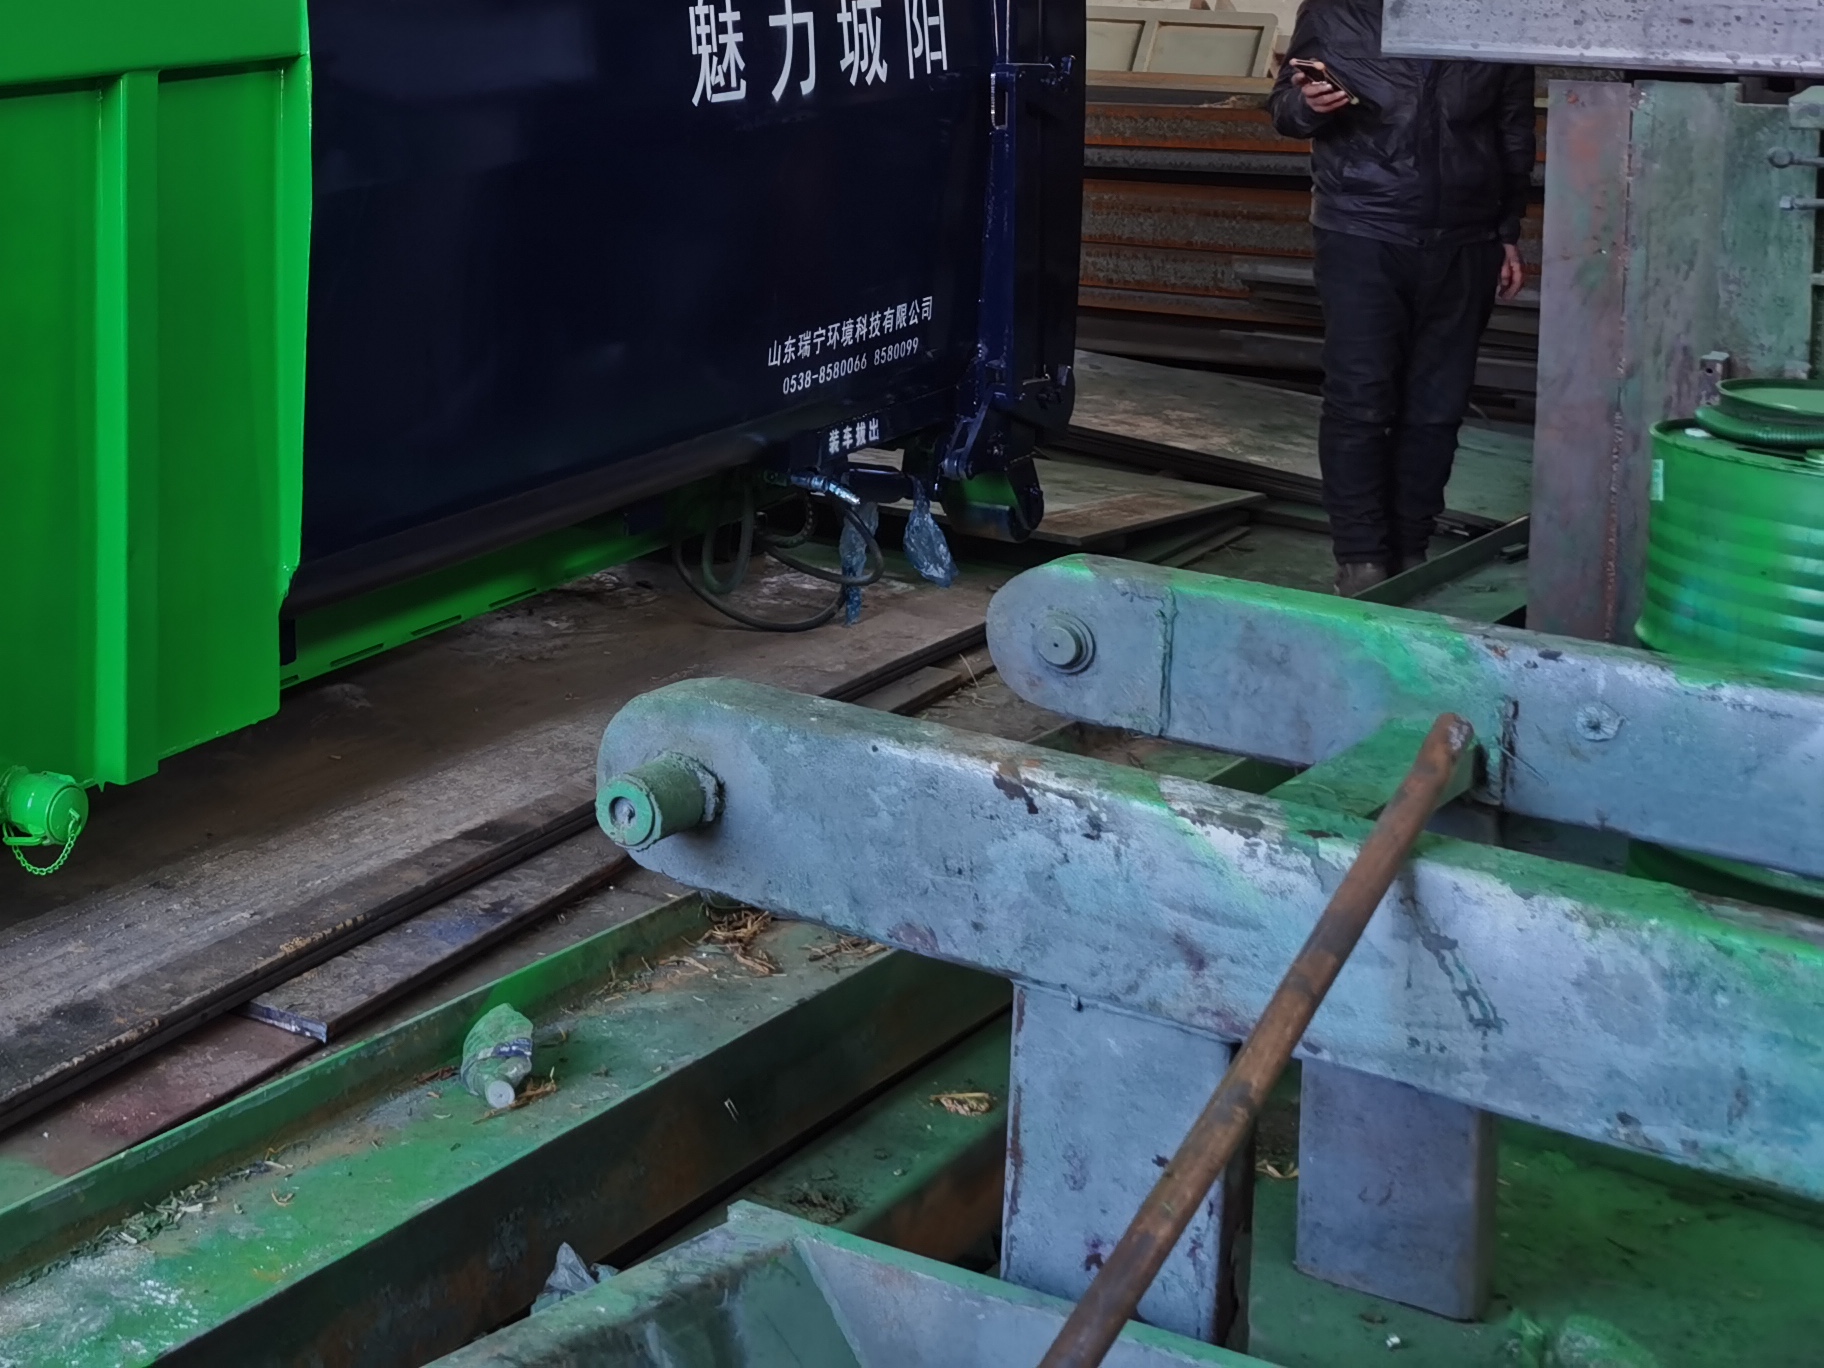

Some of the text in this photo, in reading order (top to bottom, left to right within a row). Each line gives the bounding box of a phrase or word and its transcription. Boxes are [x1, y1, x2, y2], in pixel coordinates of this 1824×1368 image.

[767, 295, 934, 368] 山东瑞宁环境科技有限公司
[782, 336, 919, 395] 0538-8580066 8580099
[828, 417, 881, 455] 装车拔出
